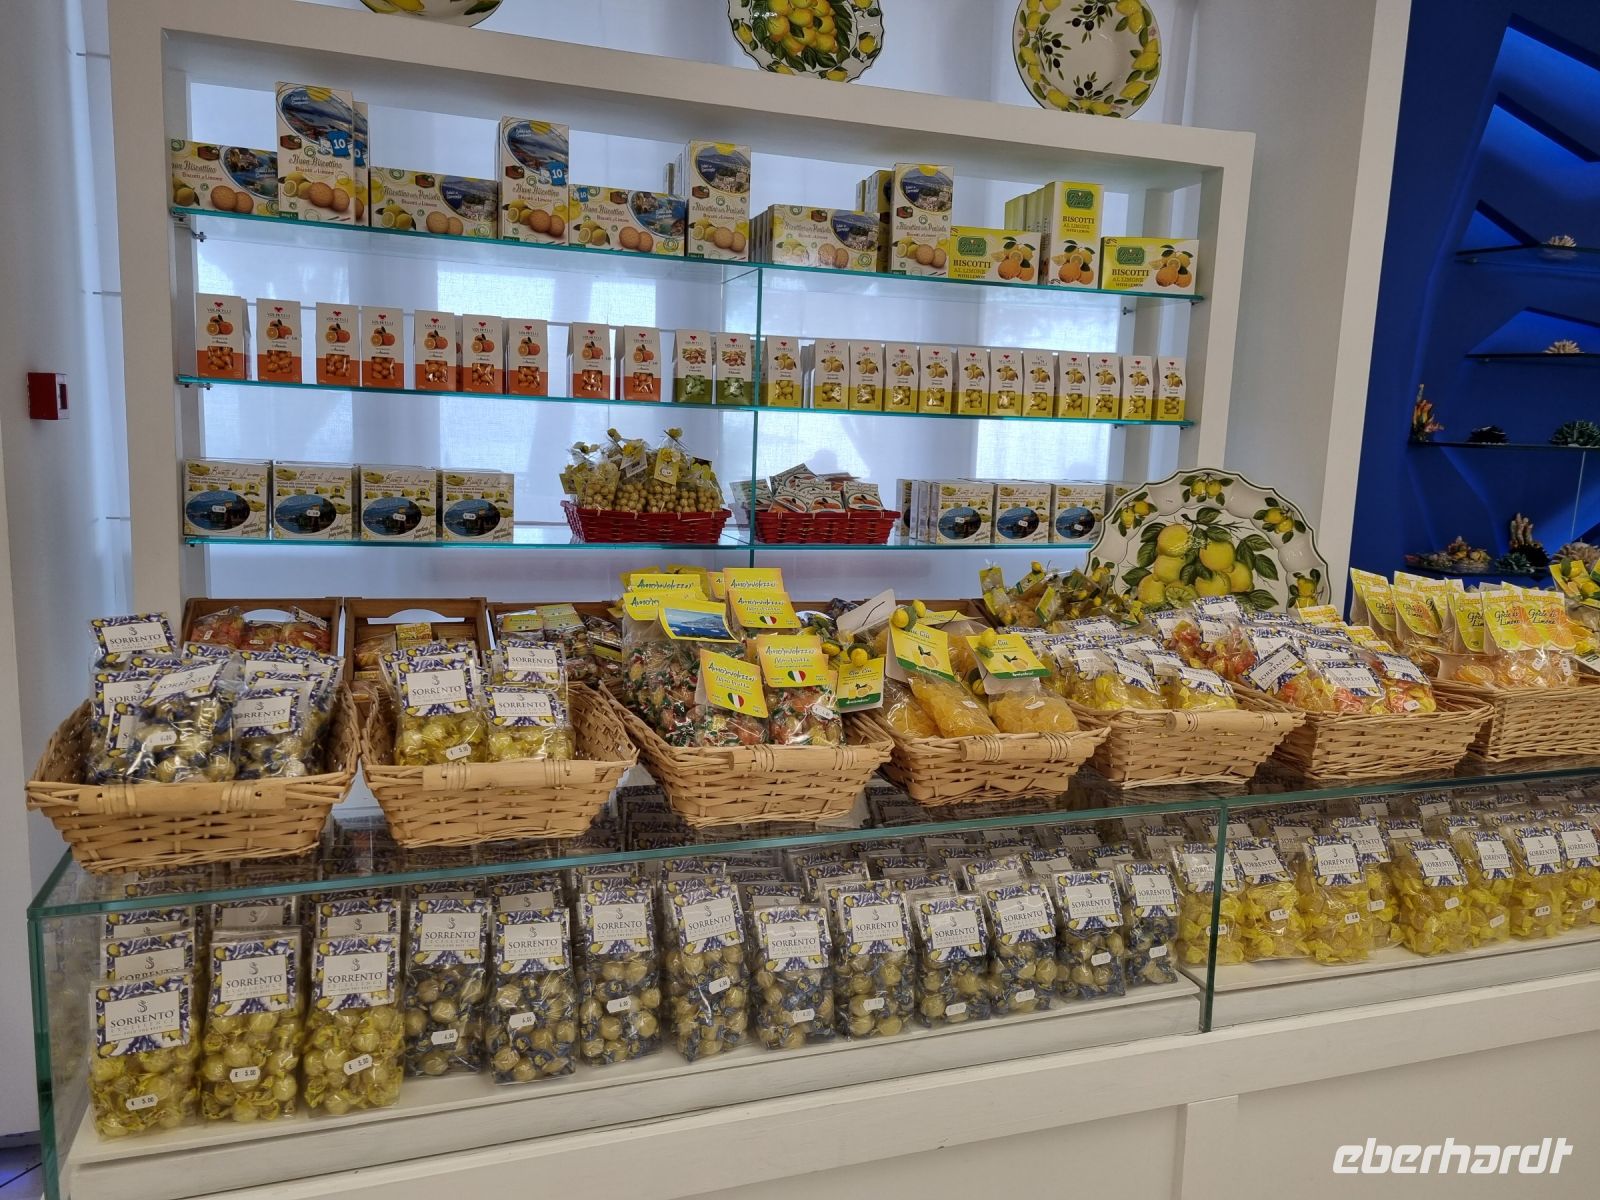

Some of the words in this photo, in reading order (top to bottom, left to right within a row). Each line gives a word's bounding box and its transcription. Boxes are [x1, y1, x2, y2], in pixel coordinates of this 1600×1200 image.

[333, 139, 346, 149] 10
[551, 169, 563, 178] 10
[1062, 215, 1095, 224] BISCOTTI
[953, 259, 991, 269] BISCOTTI
[1111, 268, 1149, 277] BISCOTTI
[1532, 617, 1556, 625] Limone
[109, 633, 162, 646] SORRENTO
[511, 656, 555, 665] SORRENTO
[1258, 653, 1291, 682] SORRENTO
[159, 674, 211, 689] SORRENTO
[412, 685, 462, 696] SORRENTO
[498, 701, 547, 709] SORRENTO
[1567, 843, 1596, 851] SORRENTO
[1528, 849, 1558, 857] SORRENTO
[1243, 858, 1277, 868] SORRENTO
[1320, 858, 1354, 867] SORRENTO
[1138, 889, 1171, 897] SORRENTO
[1071, 898, 1110, 908] SORRENTO
[1003, 910, 1043, 922] SORRENTO
[597, 920, 643, 931] SORRENTO
[688, 915, 731, 930] SORRENTO
[855, 920, 899, 931] SORRENTO
[424, 931, 477, 940] SORRENTO
[934, 927, 976, 938] SORRENTO
[508, 938, 558, 950] SORRENTO
[771, 937, 817, 948] SORRENTO
[225, 974, 284, 989] SORRENTO
[327, 971, 384, 984] SORRENTO
[110, 1009, 175, 1028] SORRENTO
